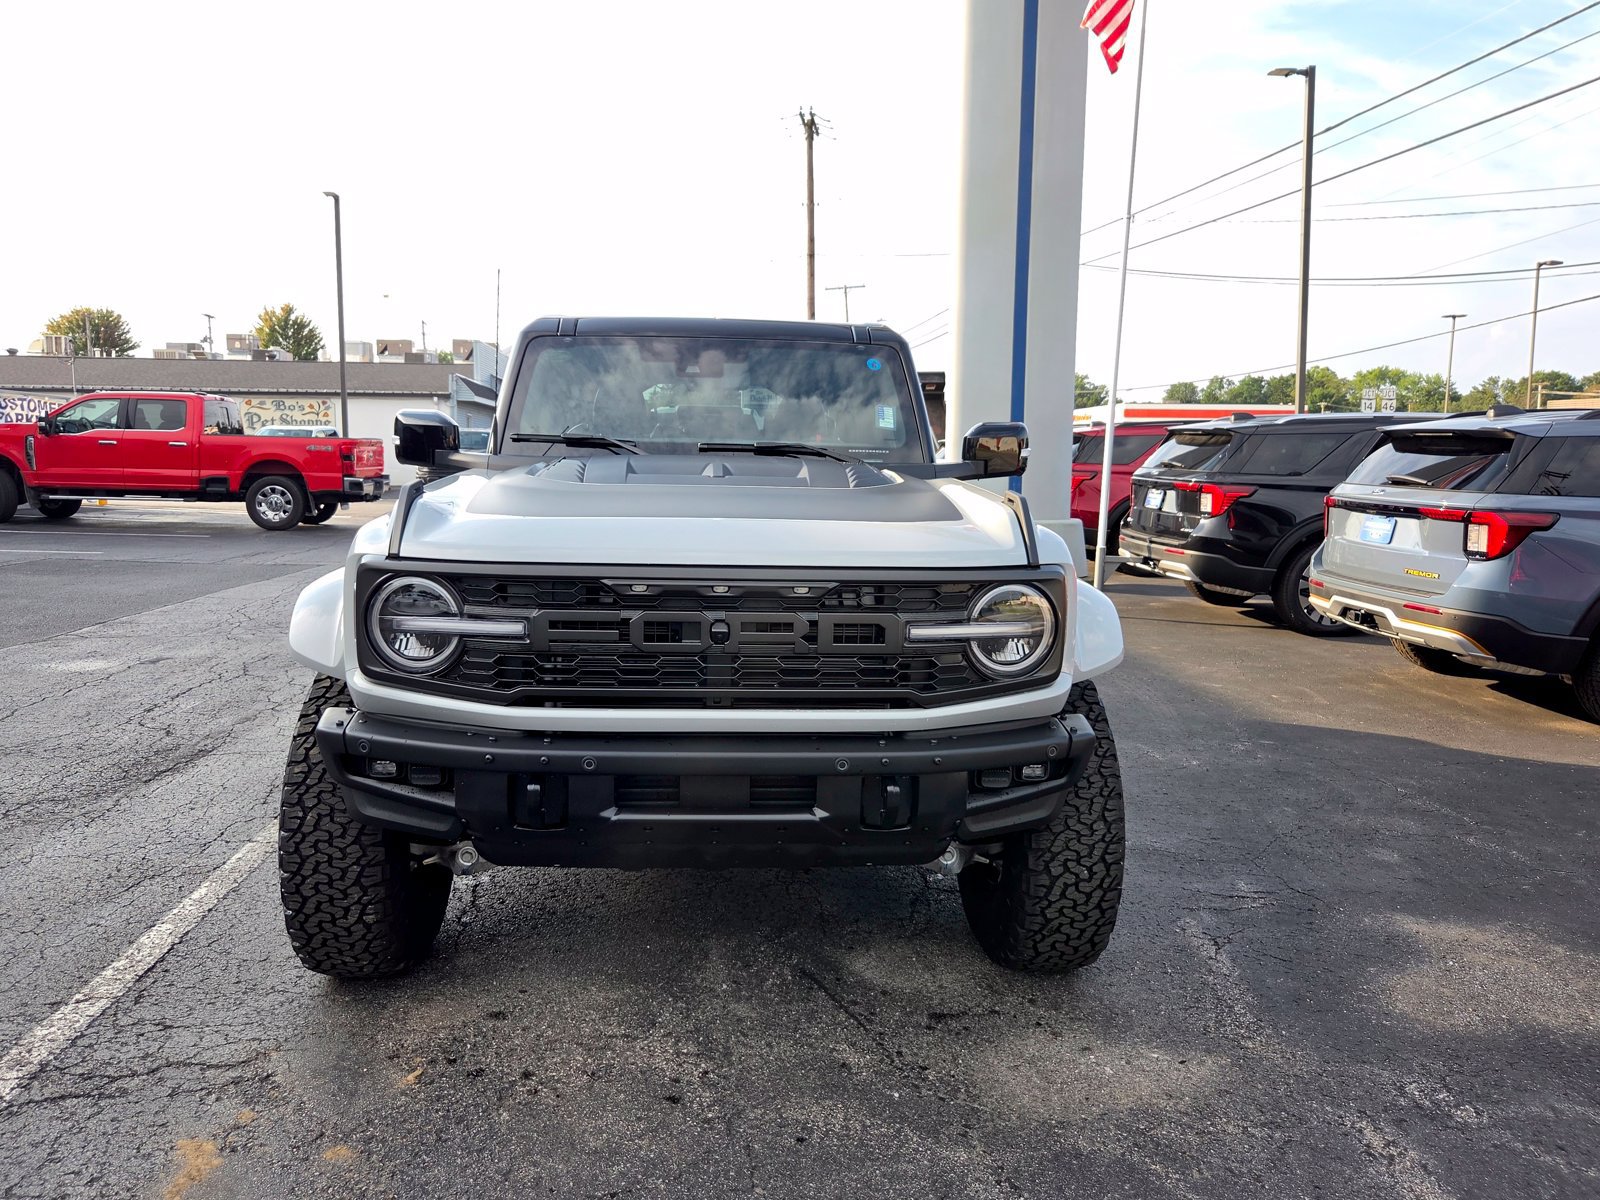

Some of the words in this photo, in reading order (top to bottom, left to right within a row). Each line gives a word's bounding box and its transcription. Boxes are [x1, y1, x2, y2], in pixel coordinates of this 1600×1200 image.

[1363, 390, 1376, 398] JCT
[1383, 390, 1396, 398] JCT
[271, 400, 305, 412] Bo's
[1364, 402, 1374, 411] 14
[1382, 402, 1396, 412] 46
[244, 412, 277, 431] Pet
[1403, 568, 1441, 580] TREMOR
[532, 609, 901, 655] FORD
